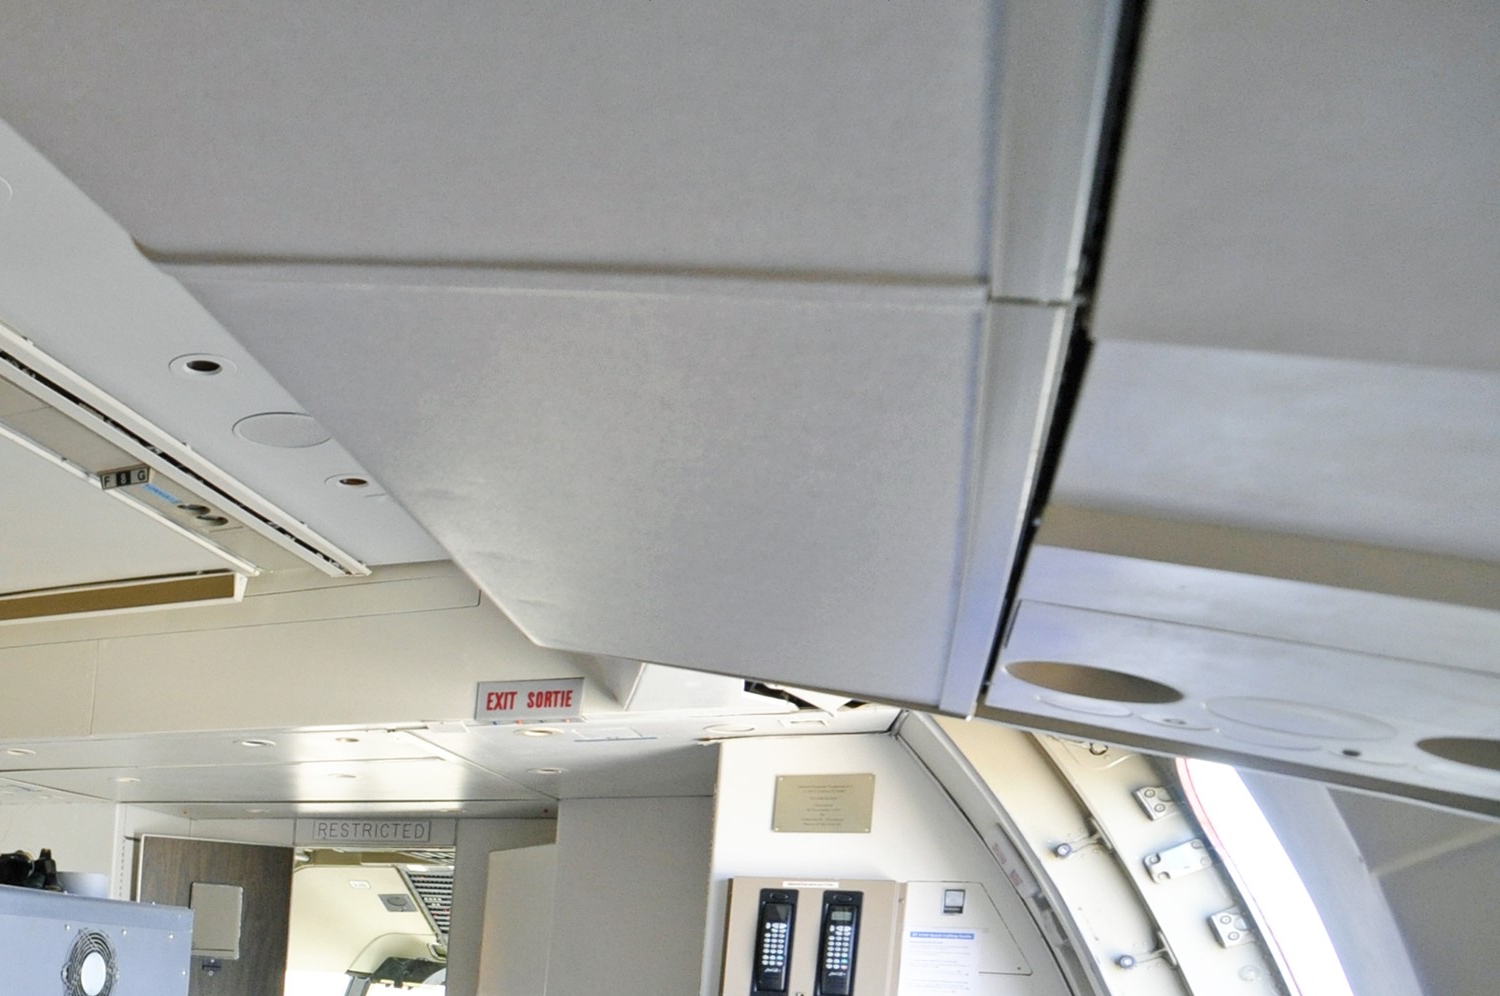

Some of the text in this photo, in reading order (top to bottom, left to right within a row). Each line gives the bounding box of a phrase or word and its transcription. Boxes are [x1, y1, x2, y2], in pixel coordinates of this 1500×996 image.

[103, 476, 111, 487] F
[137, 470, 146, 481] G
[486, 690, 574, 711] EXIT SORTIE
[317, 822, 425, 840] RESTRICTED
